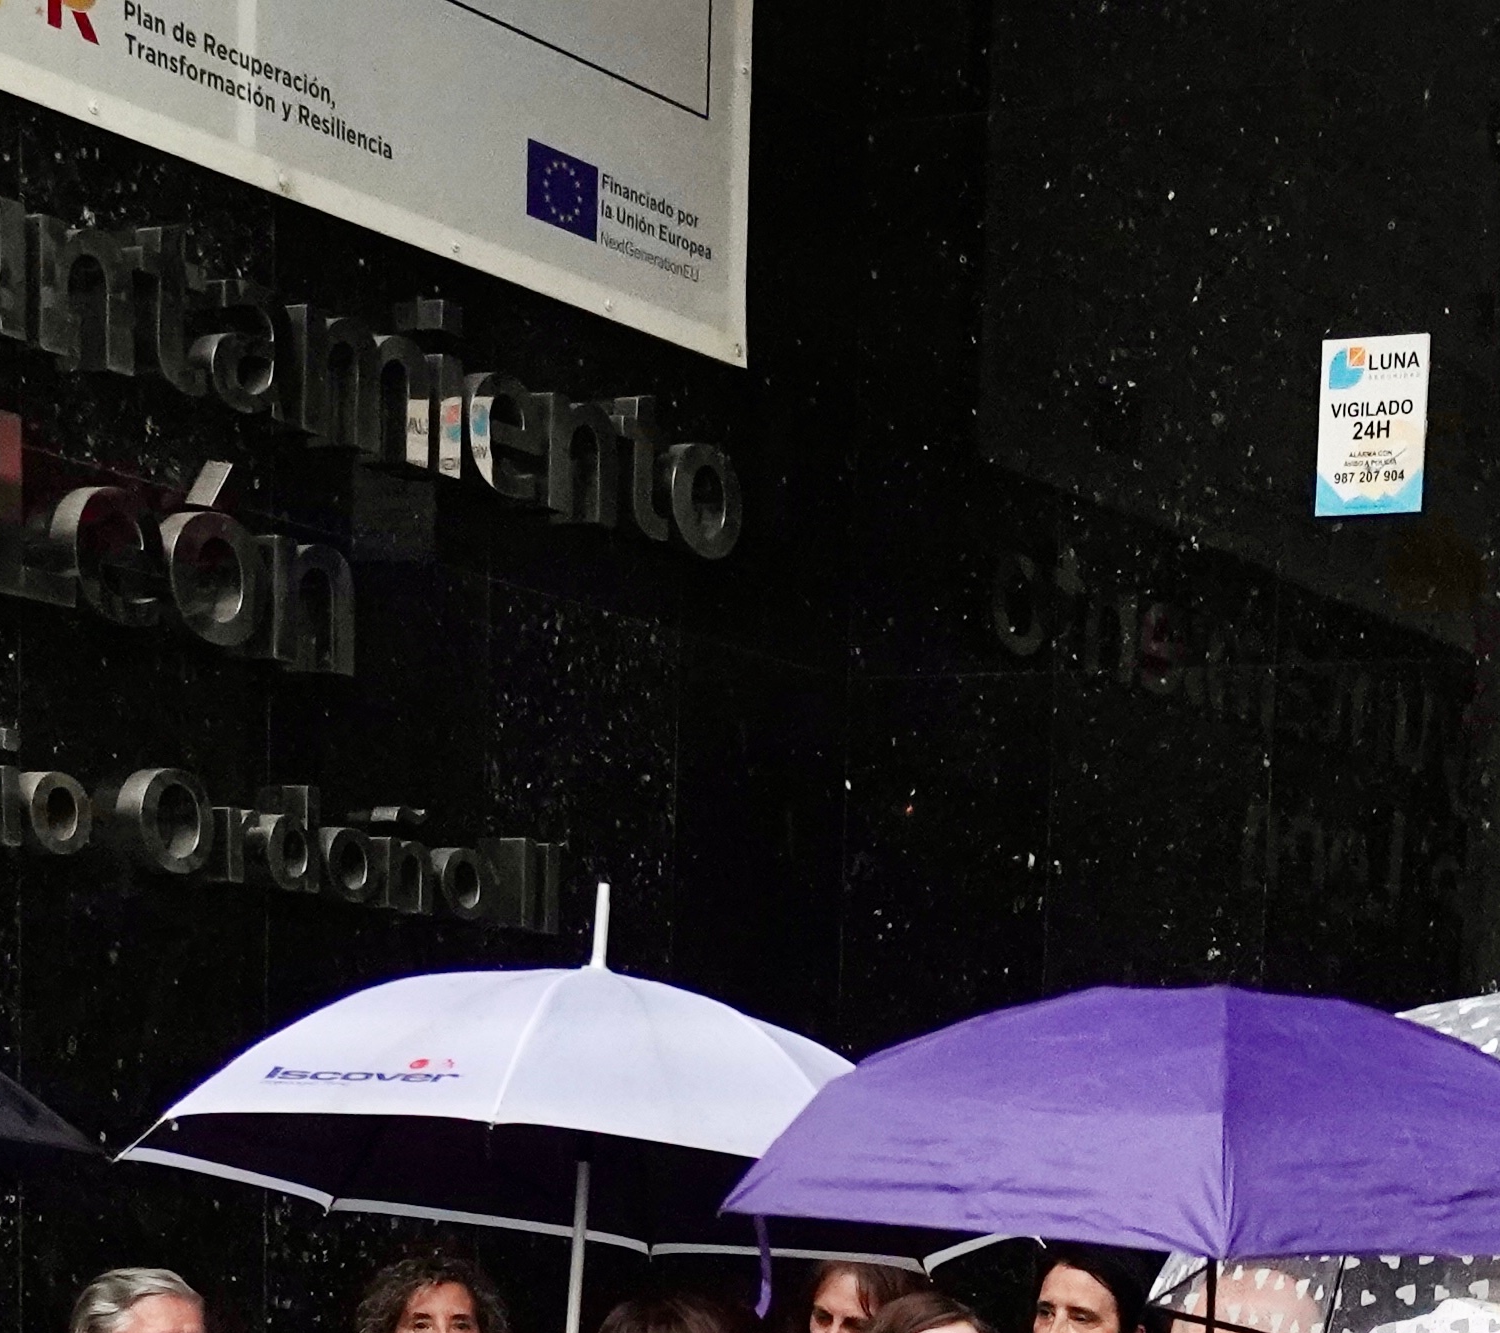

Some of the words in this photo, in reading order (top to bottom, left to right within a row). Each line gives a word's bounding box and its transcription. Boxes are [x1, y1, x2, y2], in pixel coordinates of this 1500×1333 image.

[124, 0, 165, 35] Plan
[173, 21, 197, 48] de
[203, 32, 336, 110] Recuperación,
[124, 32, 276, 113] Transformación
[281, 101, 292, 122] y
[298, 103, 393, 160] Resiliencia
[601, 173, 674, 218] Financiado
[677, 209, 700, 229] por
[601, 199, 612, 220] la
[616, 206, 655, 237] Unión
[658, 224, 712, 260] Europea
[1368, 351, 1420, 370] LUNA
[1331, 399, 1413, 418] VIGILADO
[1352, 420, 1390, 440] 24H
[1334, 472, 1355, 484] 987
[1359, 470, 1380, 483] 207
[1384, 469, 1405, 481] 904
